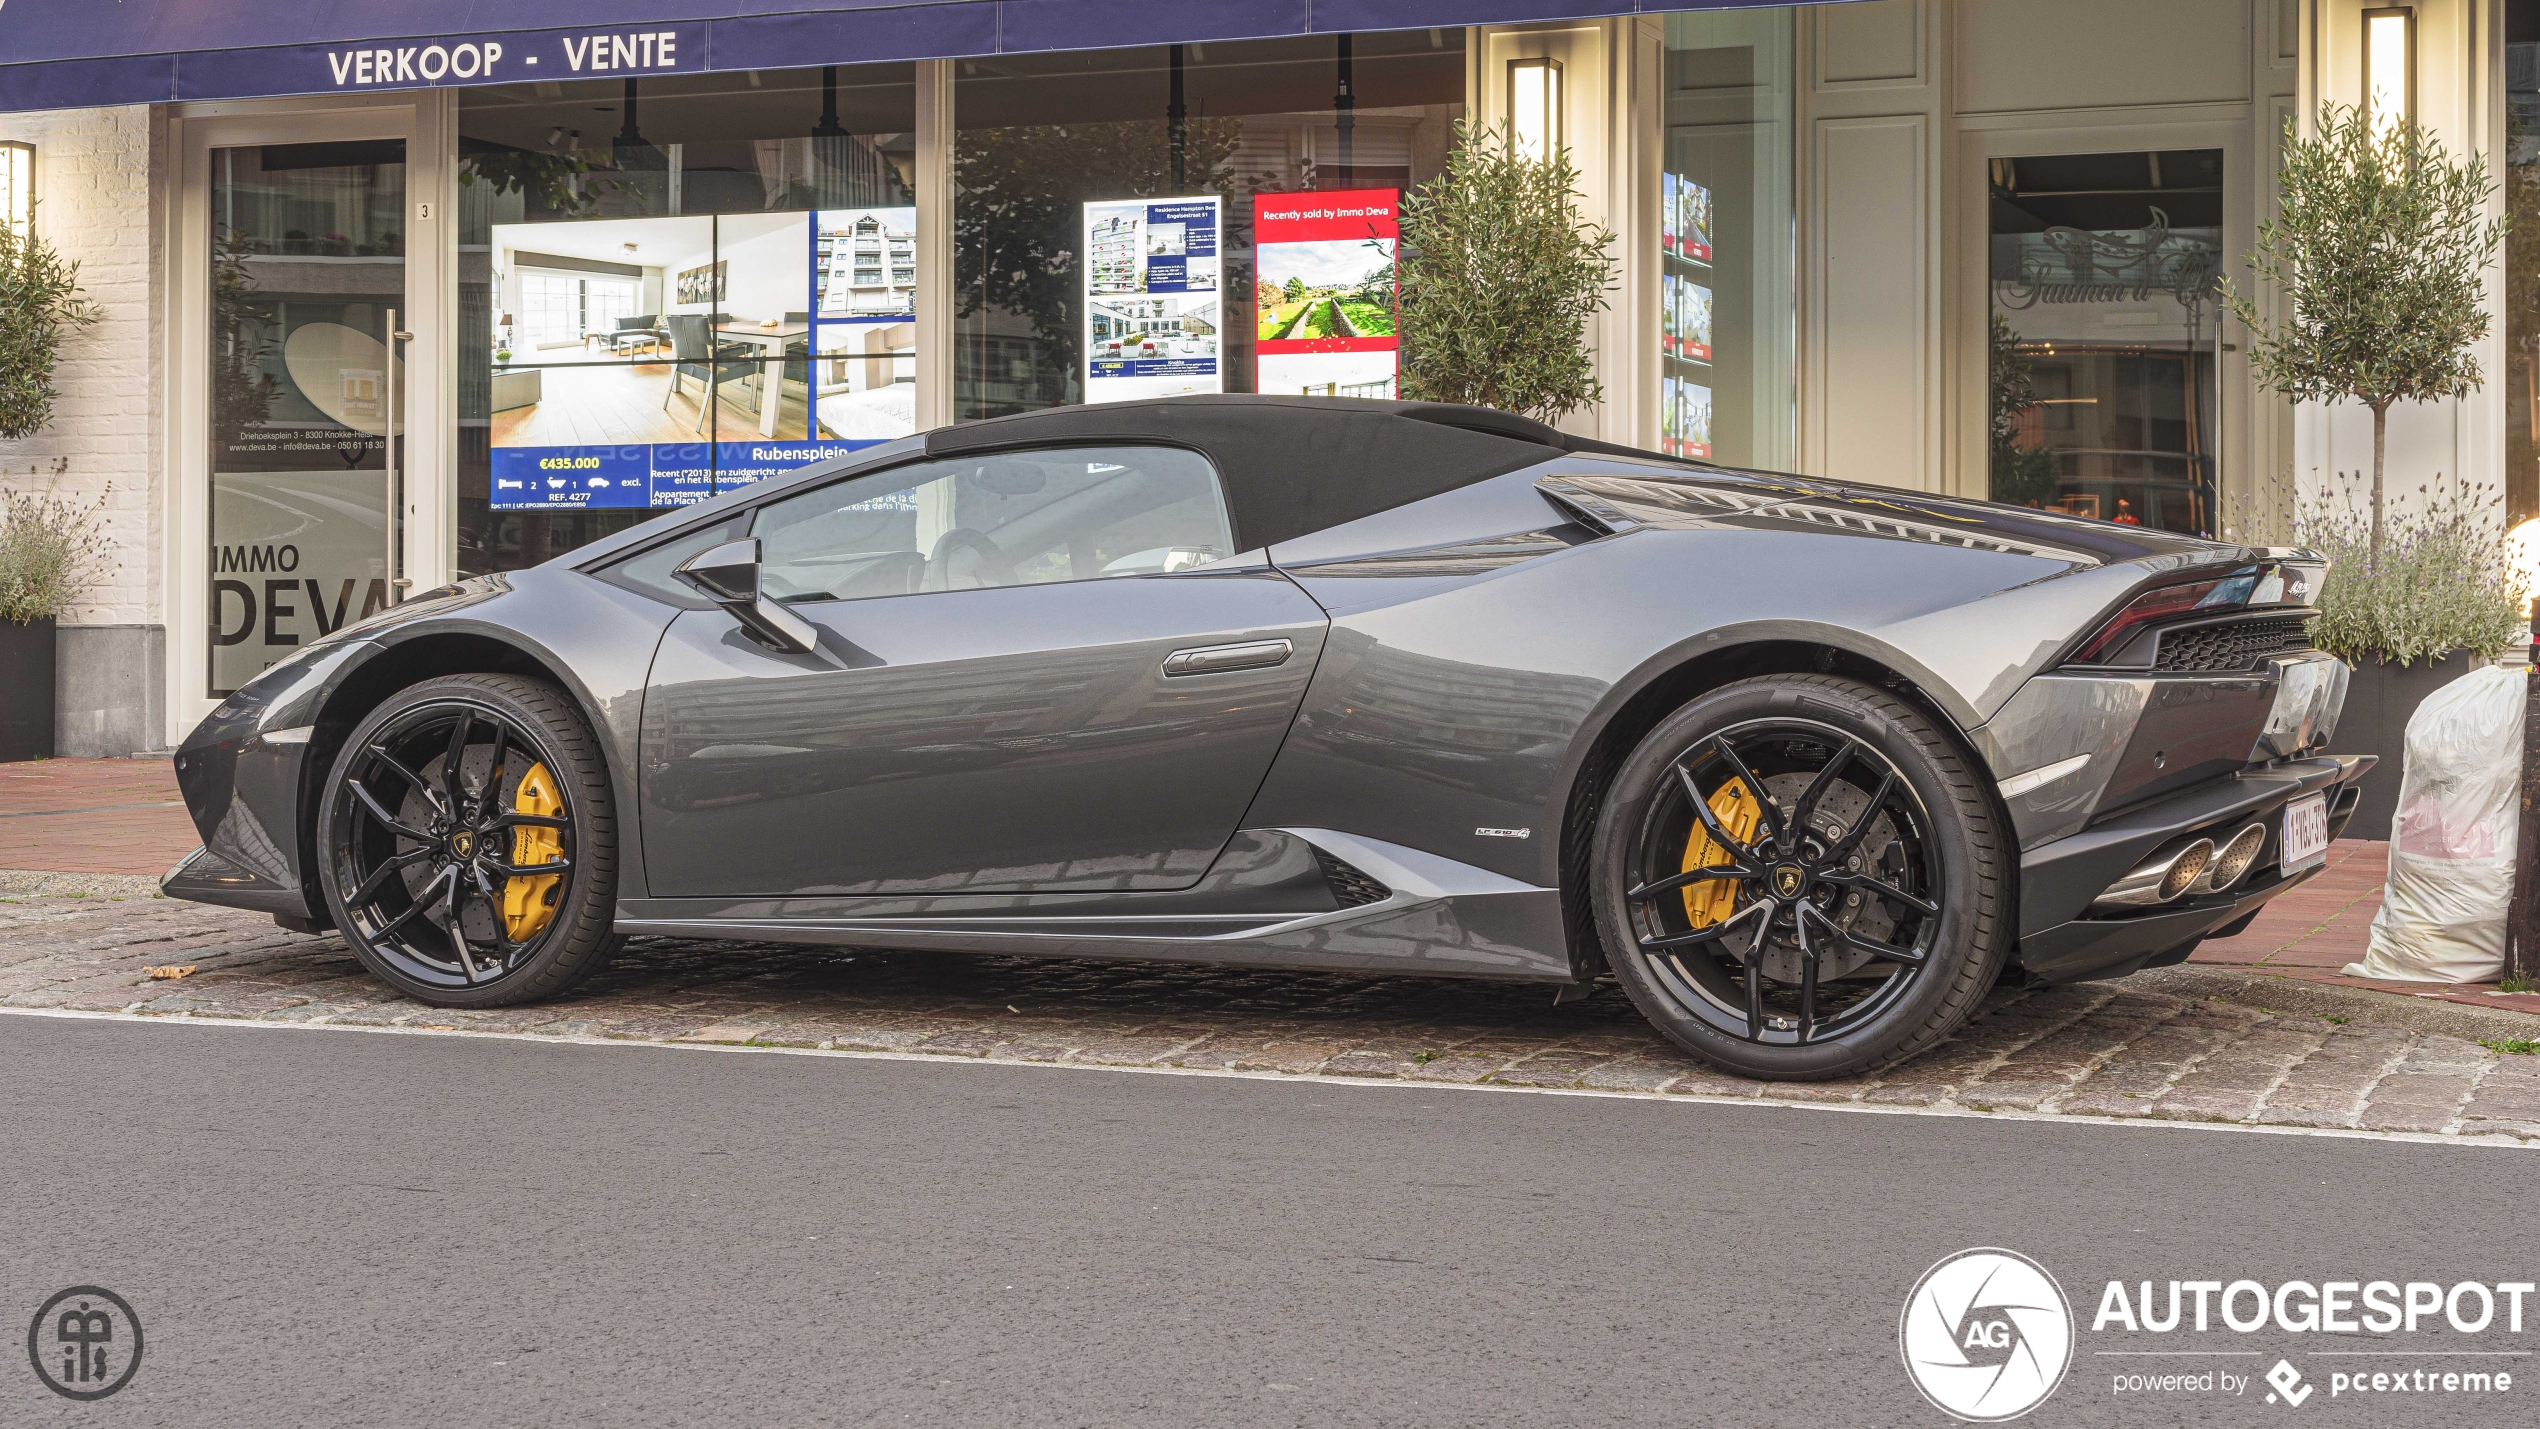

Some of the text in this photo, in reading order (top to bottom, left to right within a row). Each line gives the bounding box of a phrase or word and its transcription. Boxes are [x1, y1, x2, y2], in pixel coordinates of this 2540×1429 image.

[328, 32, 676, 85] VERKOOP - VENTE
[422, 205, 429, 218] 3
[1263, 207, 1388, 221] Recently sold by Immo Deva
[240, 432, 292, 441] Driehoeksplein
[294, 431, 298, 439] 3
[305, 431, 323, 439] 8300
[325, 430, 373, 439] Knokke-Heist
[229, 443, 276, 451] www.deva.be
[284, 442, 331, 451] info@deva.be
[338, 442, 351, 450] 050
[353, 441, 361, 449] 61
[365, 441, 373, 449] 18
[374, 441, 385, 449] 30
[752, 446, 848, 462] Rubensplein
[540, 457, 600, 470] €435.000
[651, 470, 680, 478] Recent
[681, 468, 711, 477] (°2013)
[728, 467, 775, 478] zuidgericht
[530, 478, 641, 490] 2 1 excl.
[687, 476, 701, 484] het
[549, 493, 591, 501] REF. 4277
[652, 497, 662, 505] de
[663, 497, 672, 505] la
[674, 496, 697, 505] Place
[654, 490, 709, 500] Appartement
[213, 544, 299, 573] IMMO
[213, 578, 387, 646] DEVA
